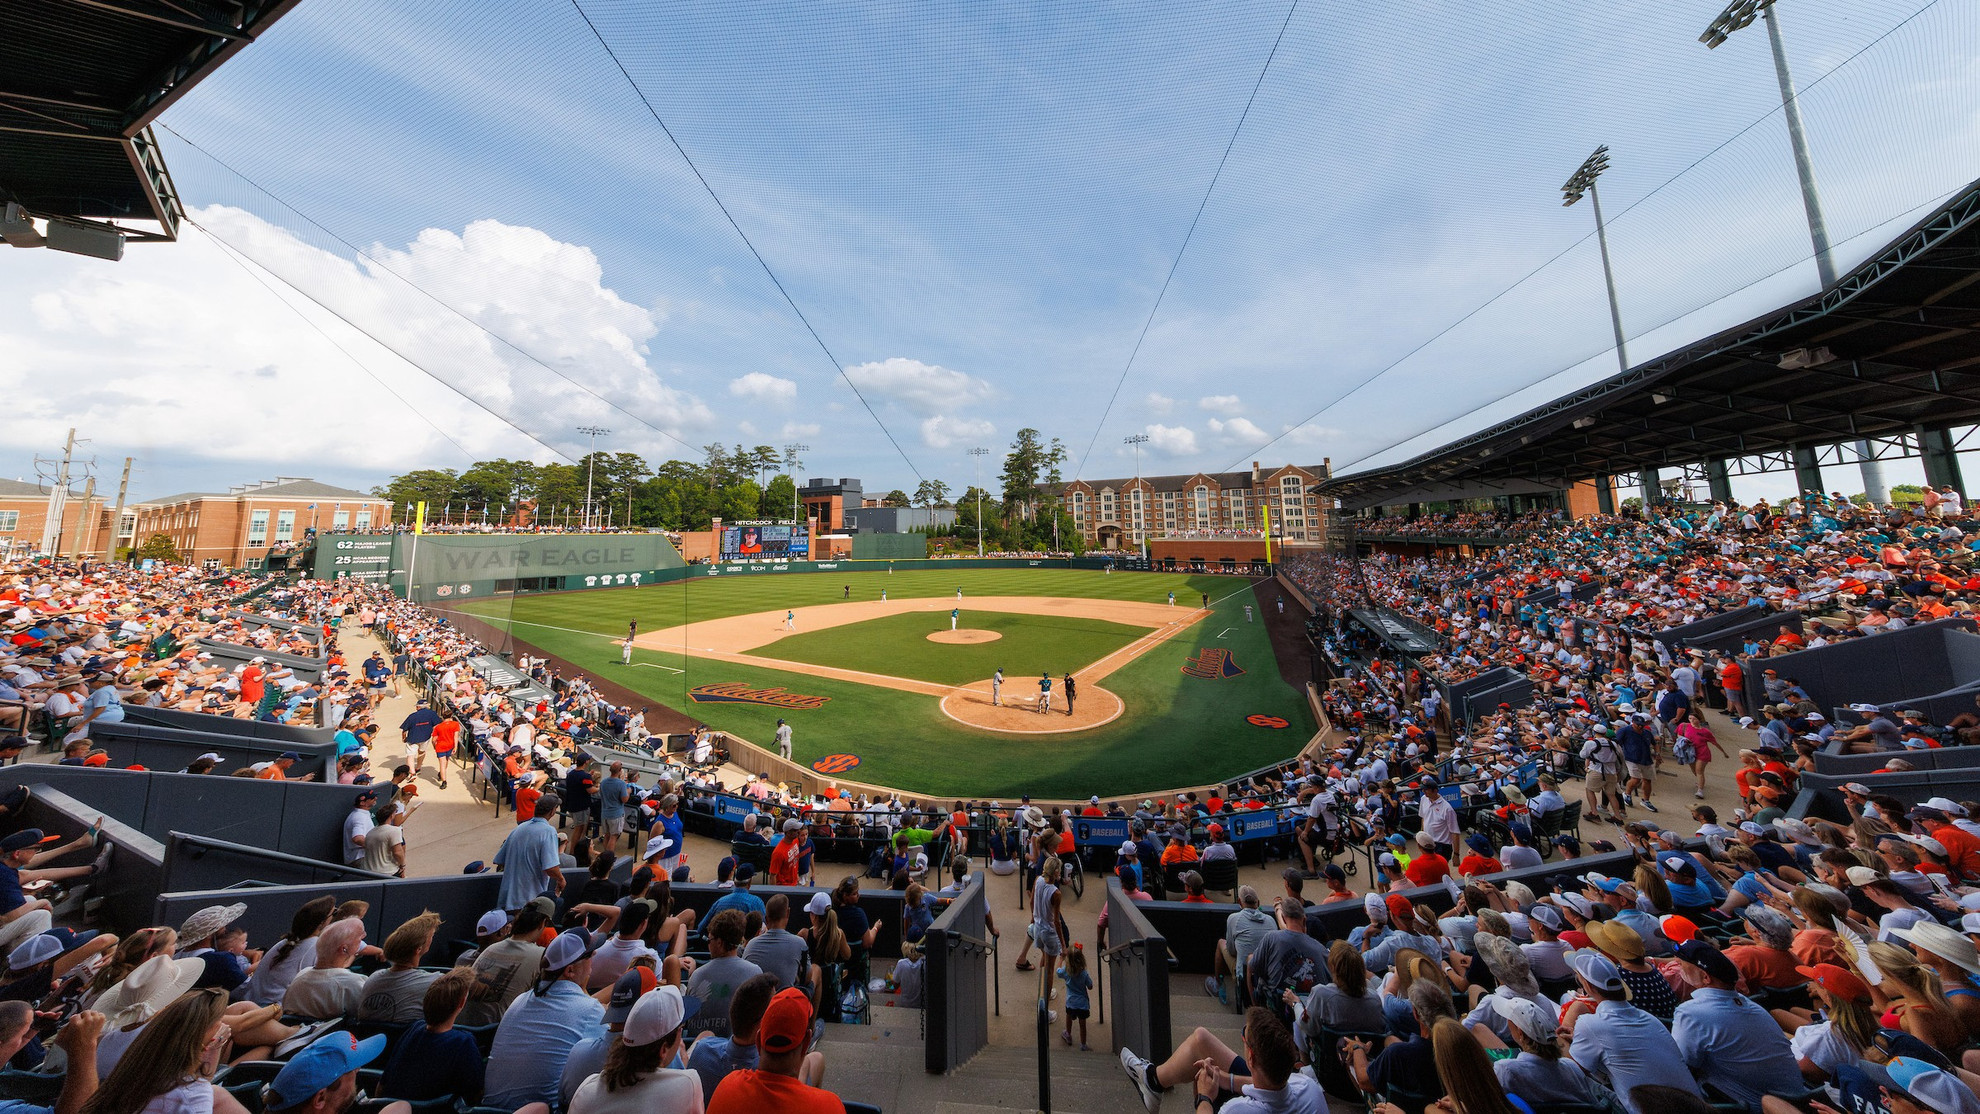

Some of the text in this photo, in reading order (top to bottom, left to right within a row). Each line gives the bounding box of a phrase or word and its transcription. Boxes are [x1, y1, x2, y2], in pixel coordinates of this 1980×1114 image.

[337, 541, 354, 549] 62
[335, 556, 352, 564] 25
[445, 548, 636, 570] WAR EAGLE
[812, 753, 862, 774] SEC
[726, 804, 750, 815] BASEBALL
[1246, 819, 1274, 831] BASEBALL
[1091, 828, 1124, 837] BASEBALL
